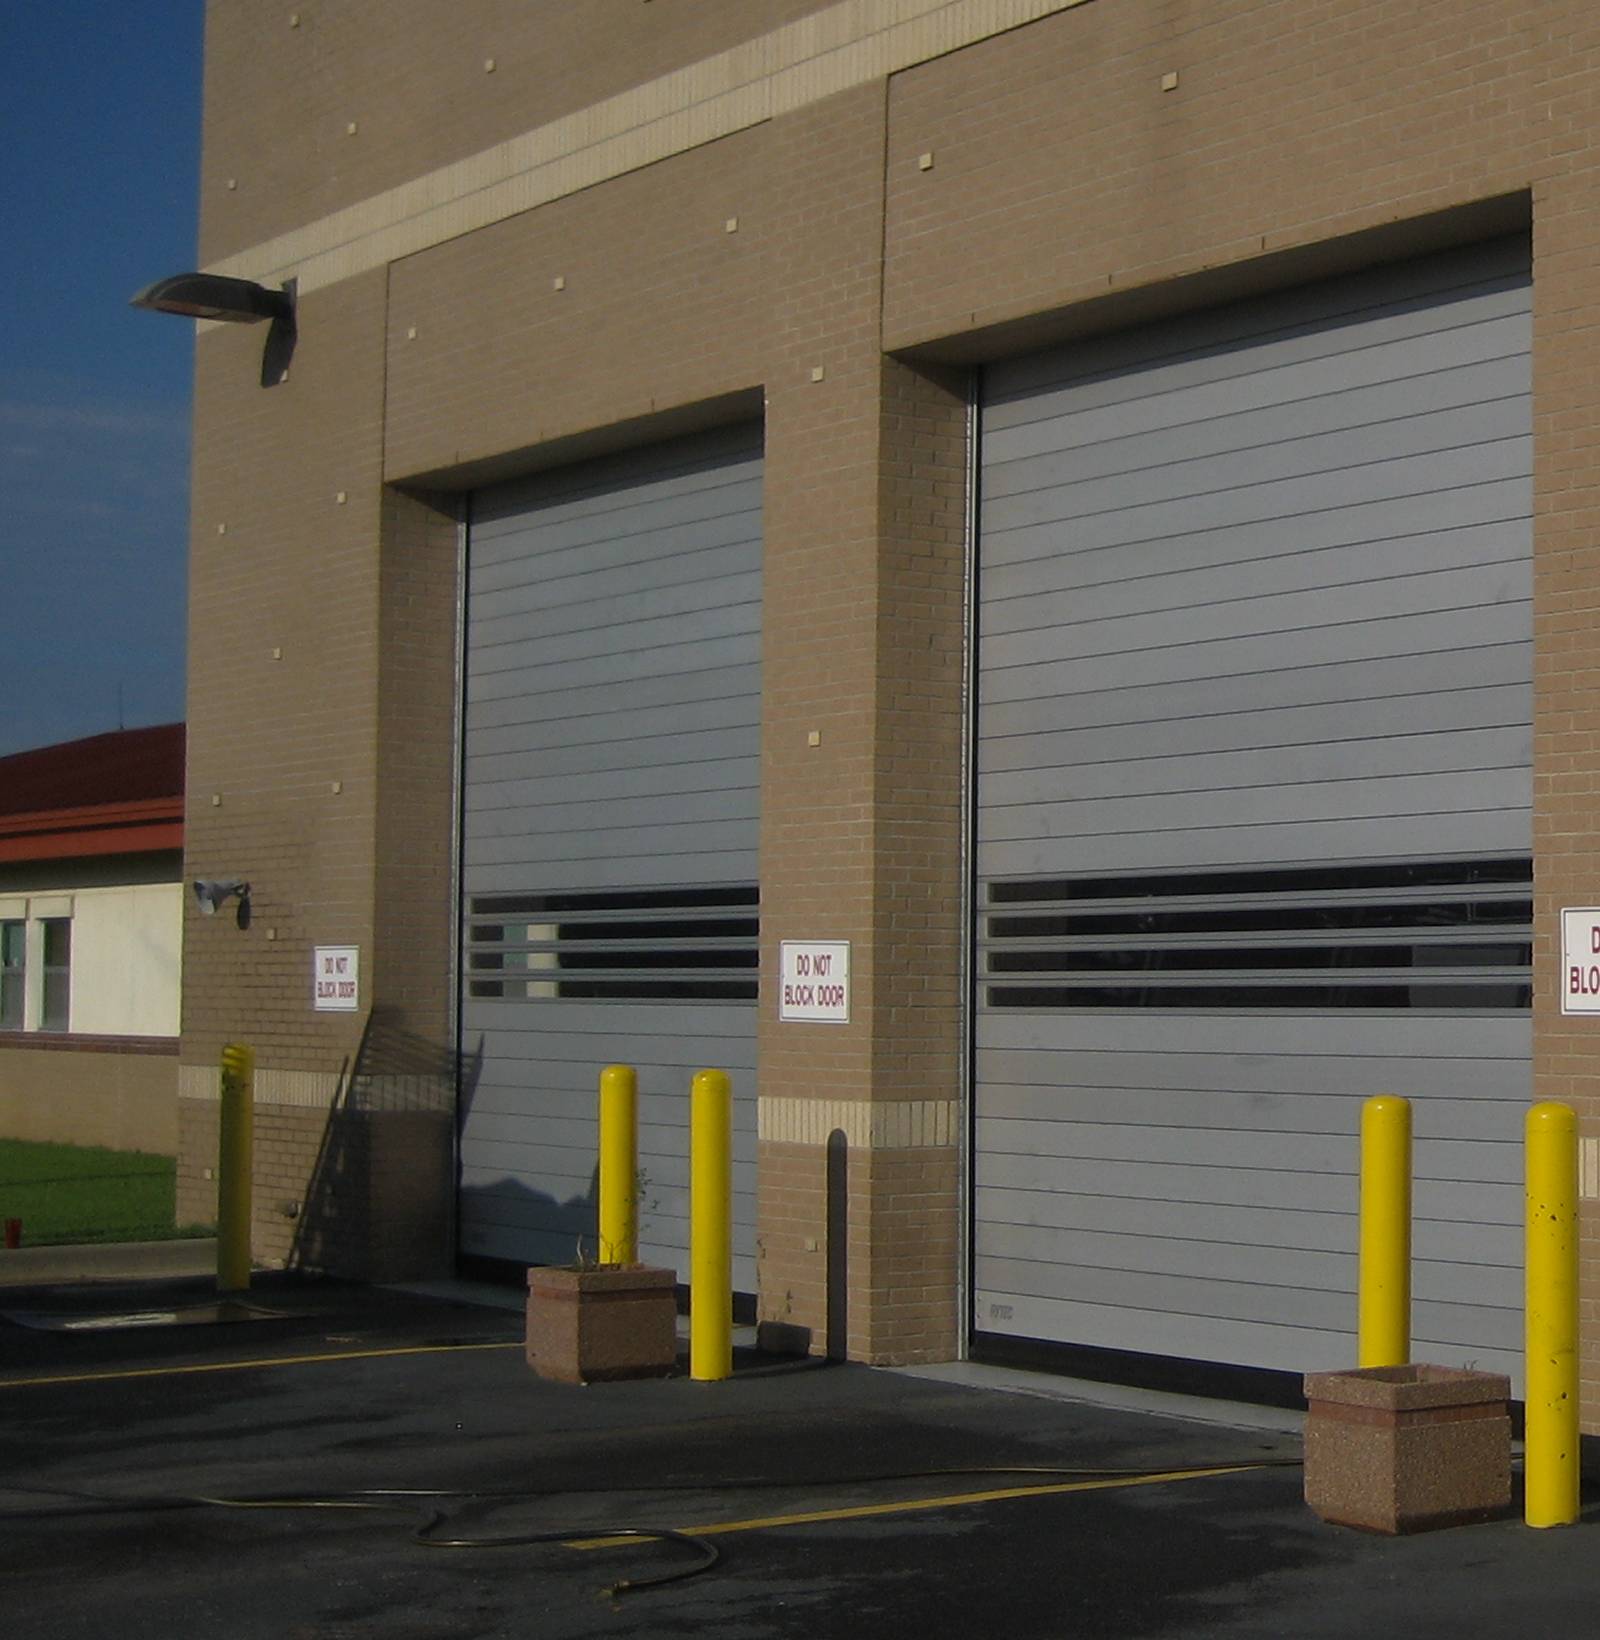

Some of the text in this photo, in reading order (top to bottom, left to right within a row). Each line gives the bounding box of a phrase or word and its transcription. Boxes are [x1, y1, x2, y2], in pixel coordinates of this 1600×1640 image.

[797, 954, 832, 976] DO NOT
[784, 984, 844, 1007] BLOCK DOOR
